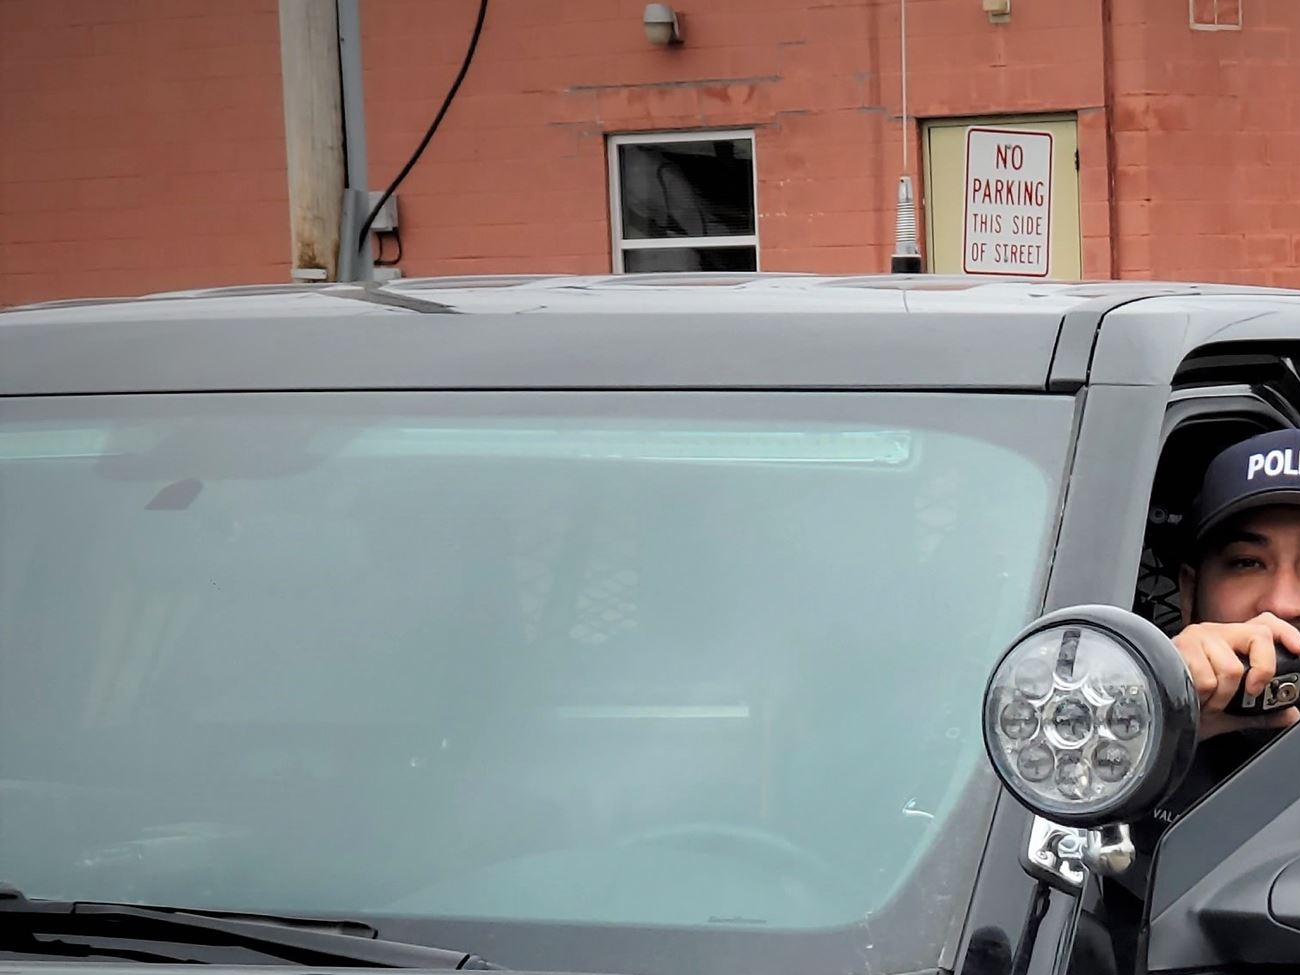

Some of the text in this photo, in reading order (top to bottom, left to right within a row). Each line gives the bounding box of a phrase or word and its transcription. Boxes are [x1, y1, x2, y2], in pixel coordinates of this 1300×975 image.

[995, 144, 1024, 171] NO
[972, 178, 1044, 207] PARKING
[972, 213, 1043, 236] THIS SIDE
[971, 242, 1041, 264] OF STREET
